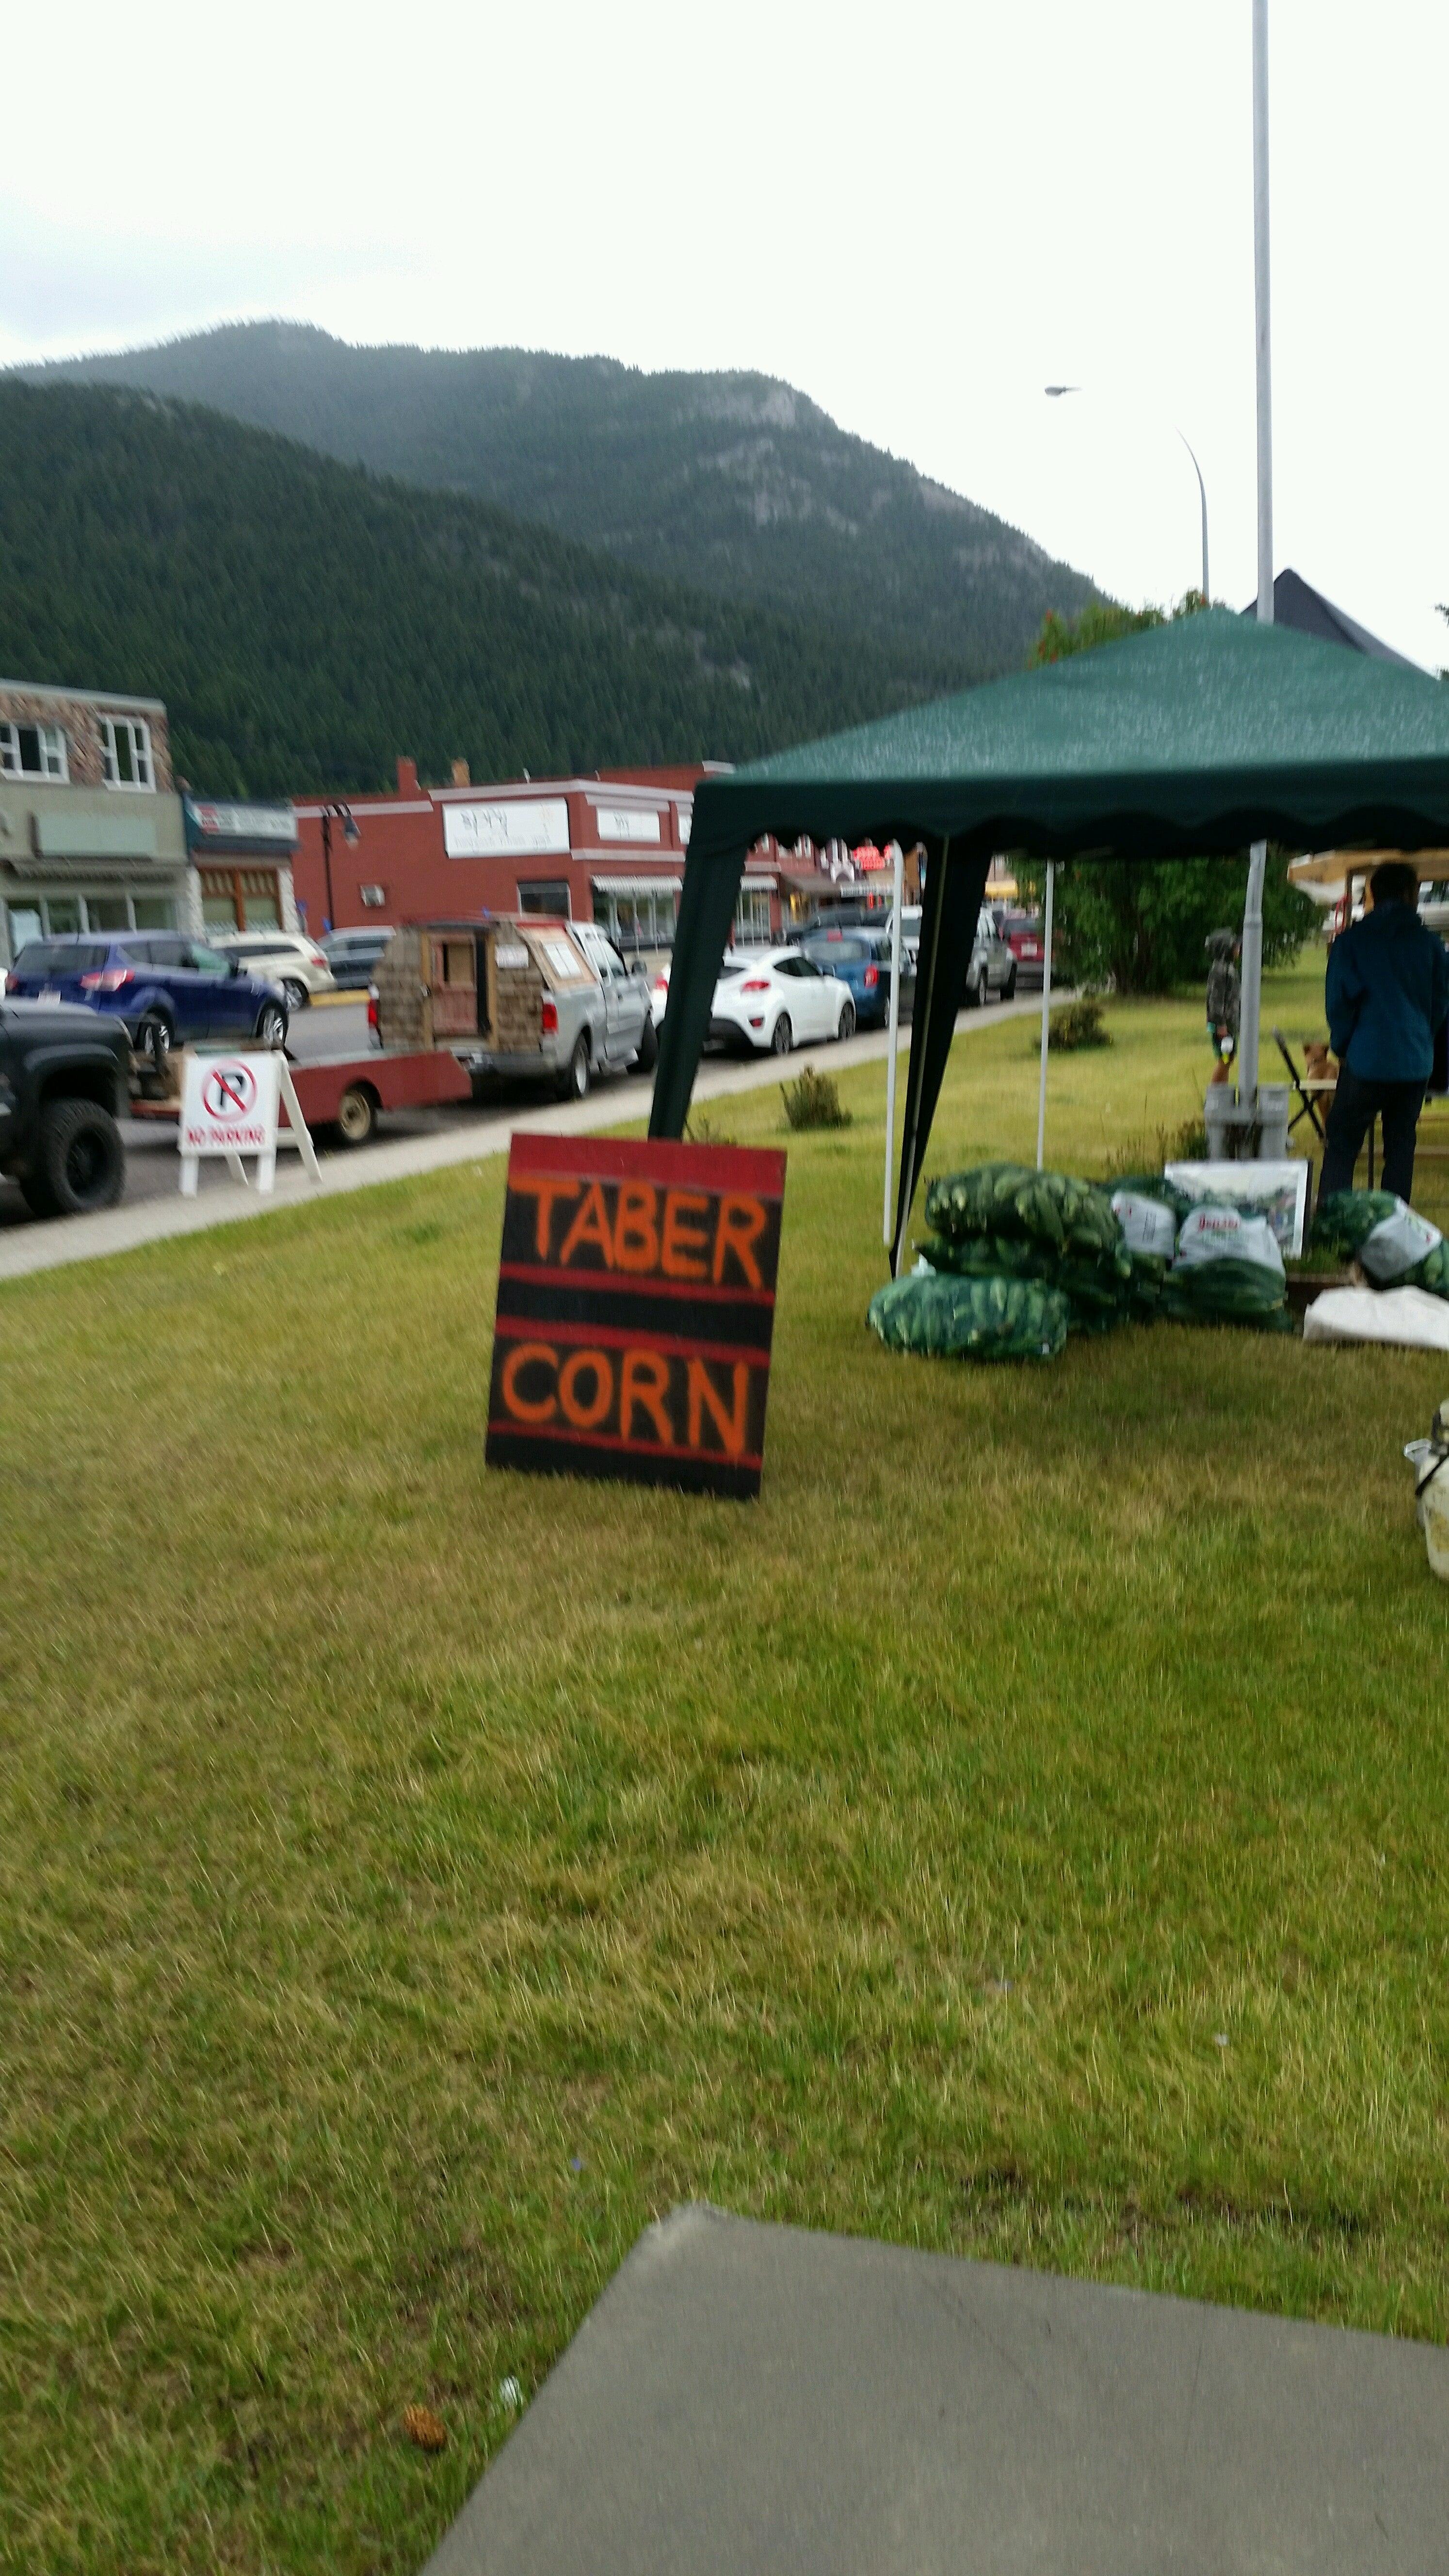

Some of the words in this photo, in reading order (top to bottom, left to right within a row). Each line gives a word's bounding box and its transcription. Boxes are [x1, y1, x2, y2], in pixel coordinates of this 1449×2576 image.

[187, 1127, 206, 1145] NO
[209, 1125, 265, 1145] PARKING
[507, 1176, 767, 1289] TABER
[502, 1342, 748, 1461] CORN
